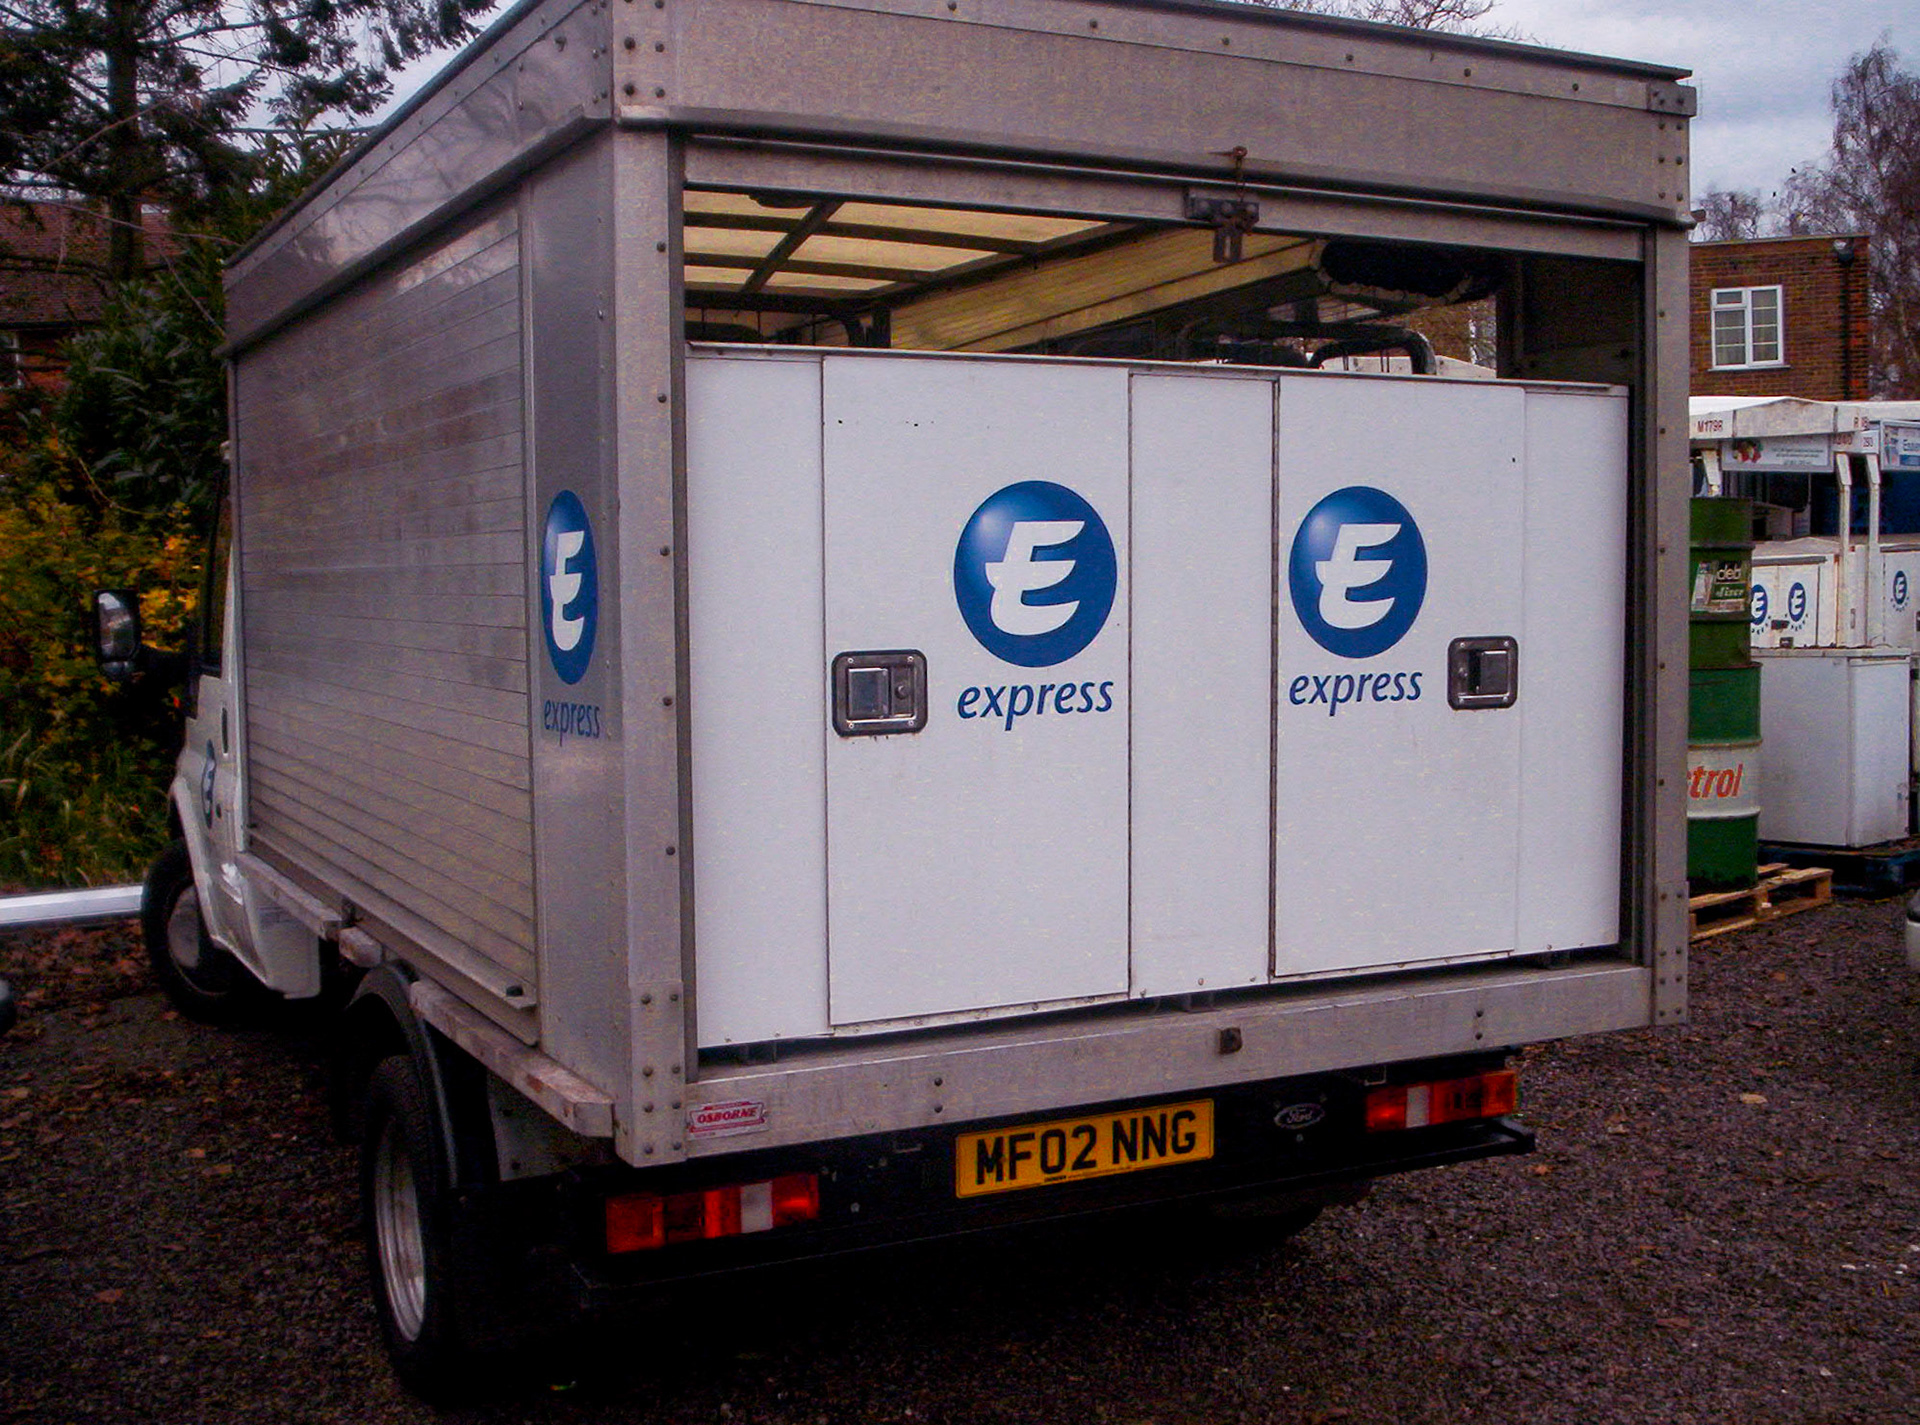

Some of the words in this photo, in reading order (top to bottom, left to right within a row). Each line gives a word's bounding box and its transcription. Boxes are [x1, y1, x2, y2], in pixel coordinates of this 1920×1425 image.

[956, 680, 1115, 732] express
[1288, 670, 1424, 718] express
[544, 699, 601, 748] express
[697, 1107, 759, 1124] OSBORNE
[1286, 1108, 1314, 1124] Ford
[975, 1124, 1098, 1186] MF02
[1112, 1109, 1198, 1165] NNG
